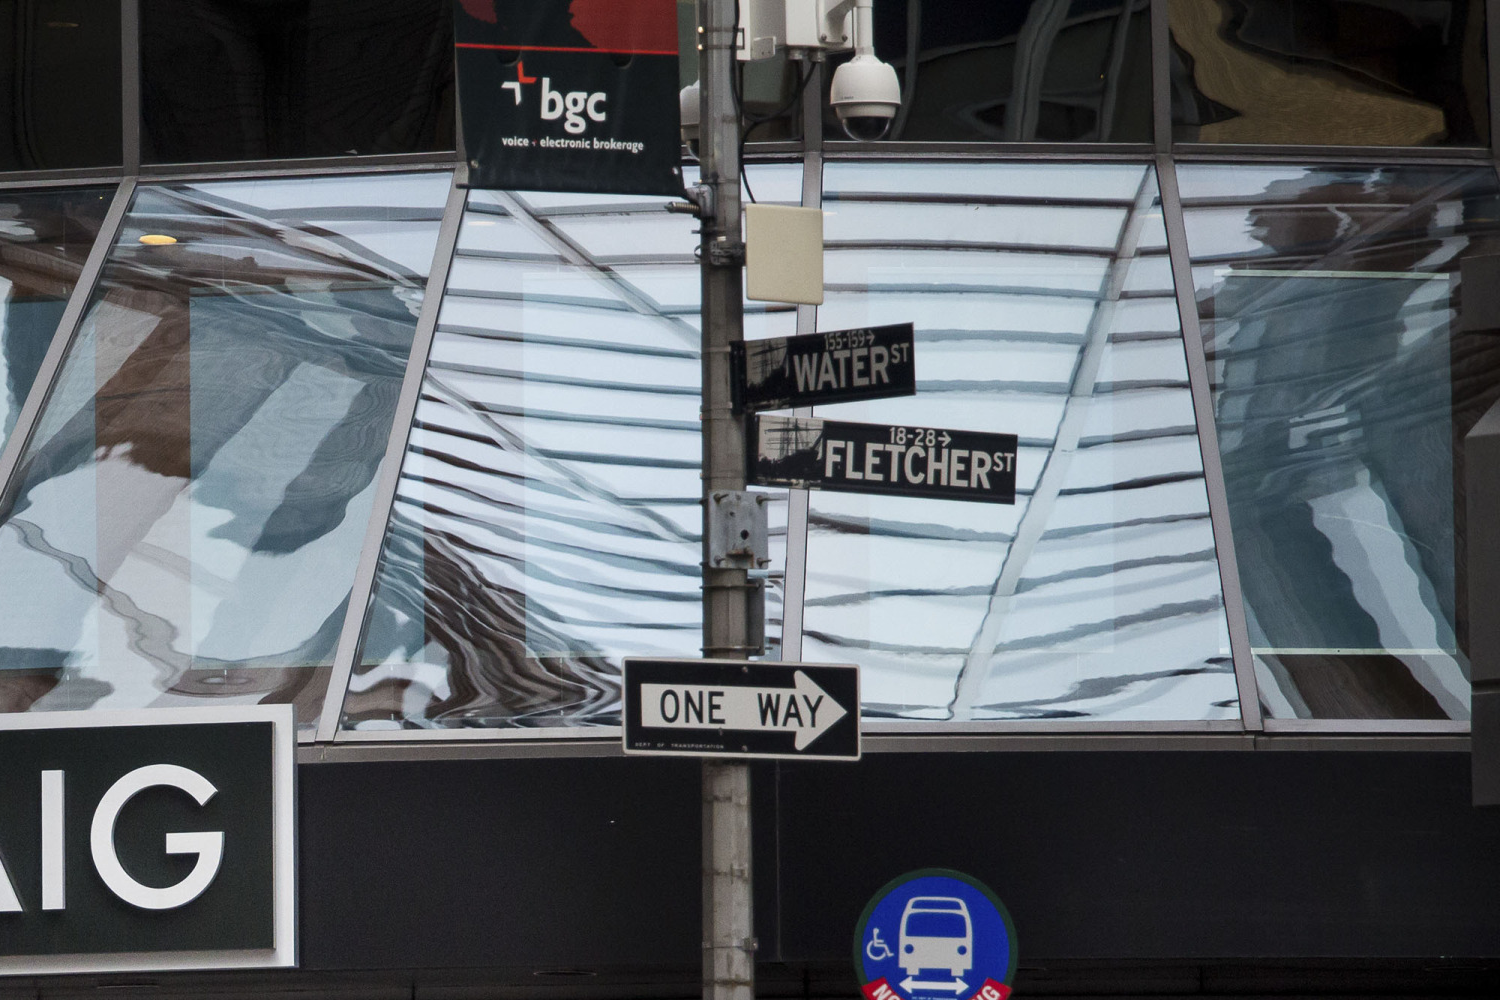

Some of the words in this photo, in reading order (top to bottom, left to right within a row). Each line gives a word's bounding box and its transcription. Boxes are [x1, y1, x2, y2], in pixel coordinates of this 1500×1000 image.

[541, 77, 607, 134] bgc
[502, 136, 529, 147] voice
[540, 136, 590, 149] electronic
[593, 138, 645, 154] brokerage
[825, 330, 866, 351] 155-159
[793, 346, 890, 393] WATER
[891, 342, 910, 364] ST
[889, 426, 936, 447] 18-28
[825, 440, 992, 489] FLETCHER
[993, 452, 1014, 472] ST
[660, 689, 726, 724] ONE
[757, 693, 824, 728] WAY
